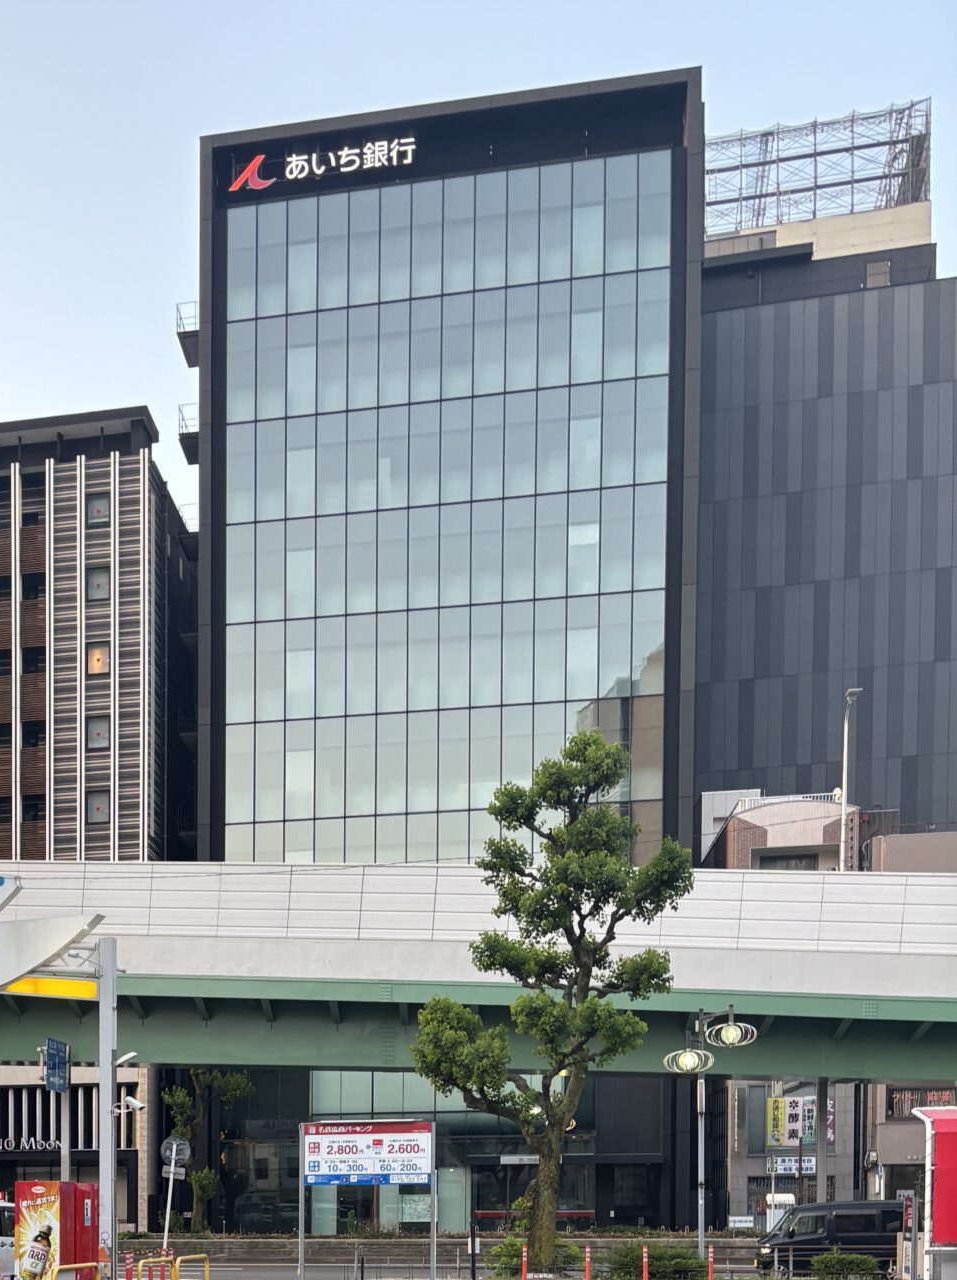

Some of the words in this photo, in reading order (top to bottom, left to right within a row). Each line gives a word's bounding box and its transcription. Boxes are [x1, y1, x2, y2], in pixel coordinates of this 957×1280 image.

[285, 137, 417, 180] あいち銀行
